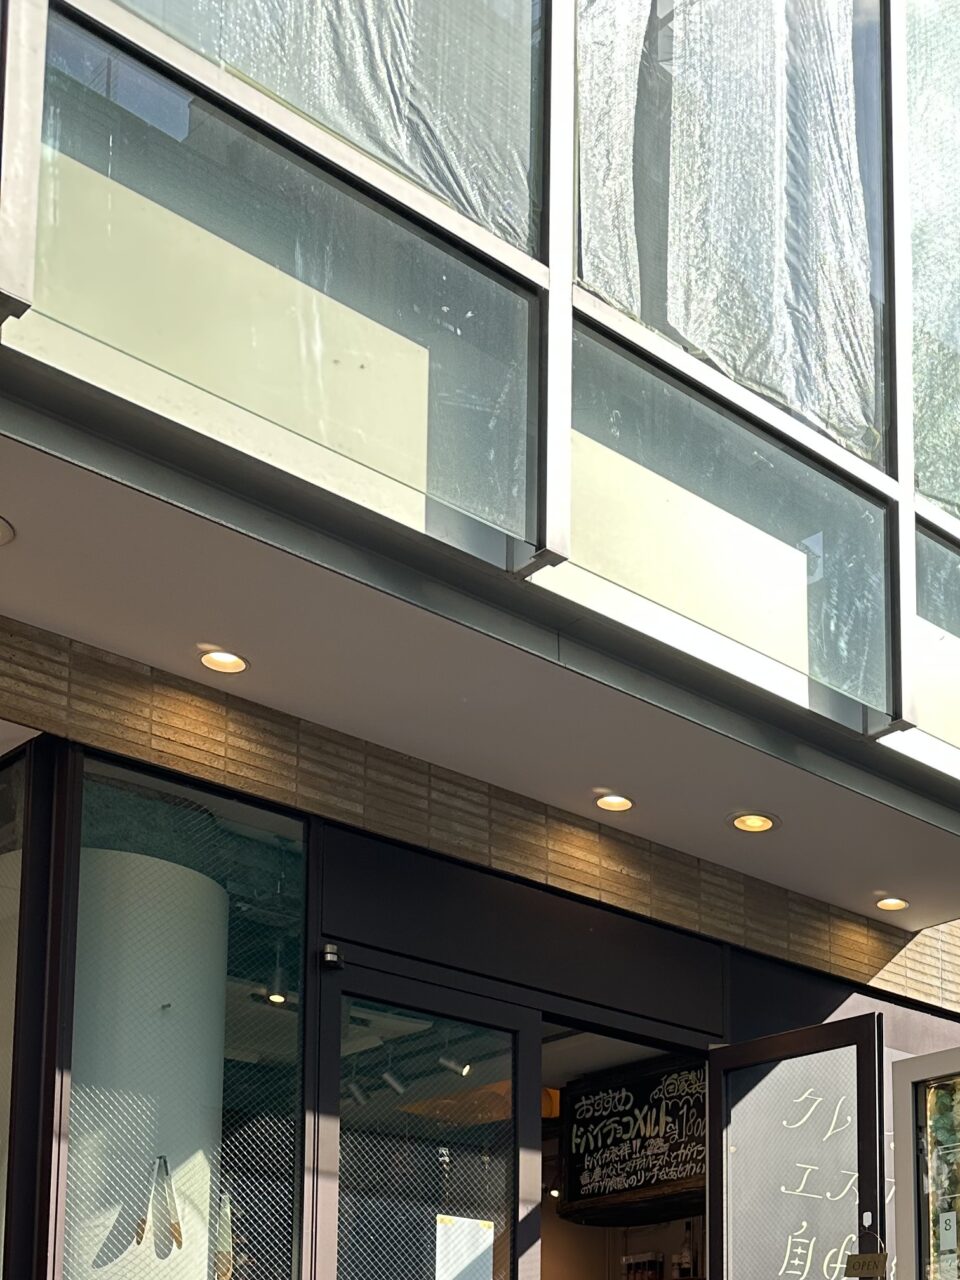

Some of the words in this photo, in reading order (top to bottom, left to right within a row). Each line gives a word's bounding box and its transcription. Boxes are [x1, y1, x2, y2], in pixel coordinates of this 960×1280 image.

[575, 1088, 634, 1119] おすすめ
[944, 1218, 952, 1232] 8
[852, 1260, 880, 1271] OPEN
